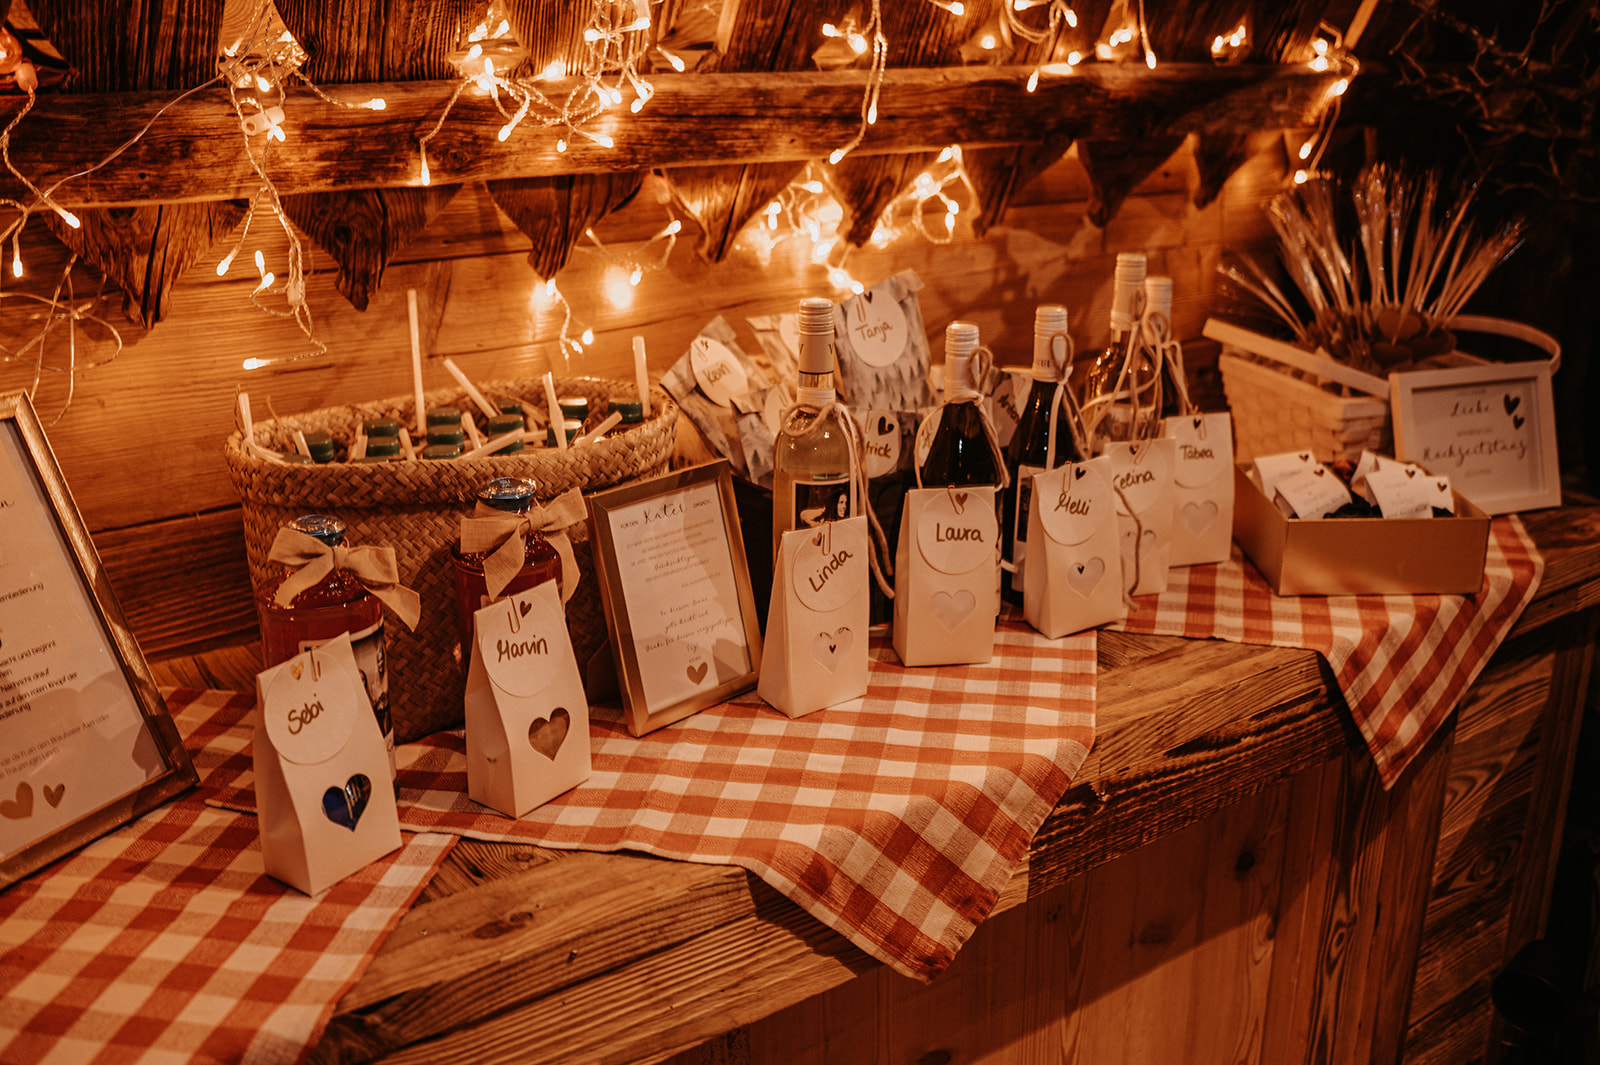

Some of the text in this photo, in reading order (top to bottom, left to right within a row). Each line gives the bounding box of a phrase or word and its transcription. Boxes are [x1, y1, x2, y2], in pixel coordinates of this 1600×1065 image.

[854, 318, 893, 343] Tanja
[865, 441, 892, 459] trick
[1179, 444, 1215, 461] Tabea
[643, 502, 687, 525] Kater
[936, 522, 984, 543] Laura
[808, 549, 853, 593] Linda
[496, 634, 549, 663] Marvin
[287, 692, 325, 735] Sebi
